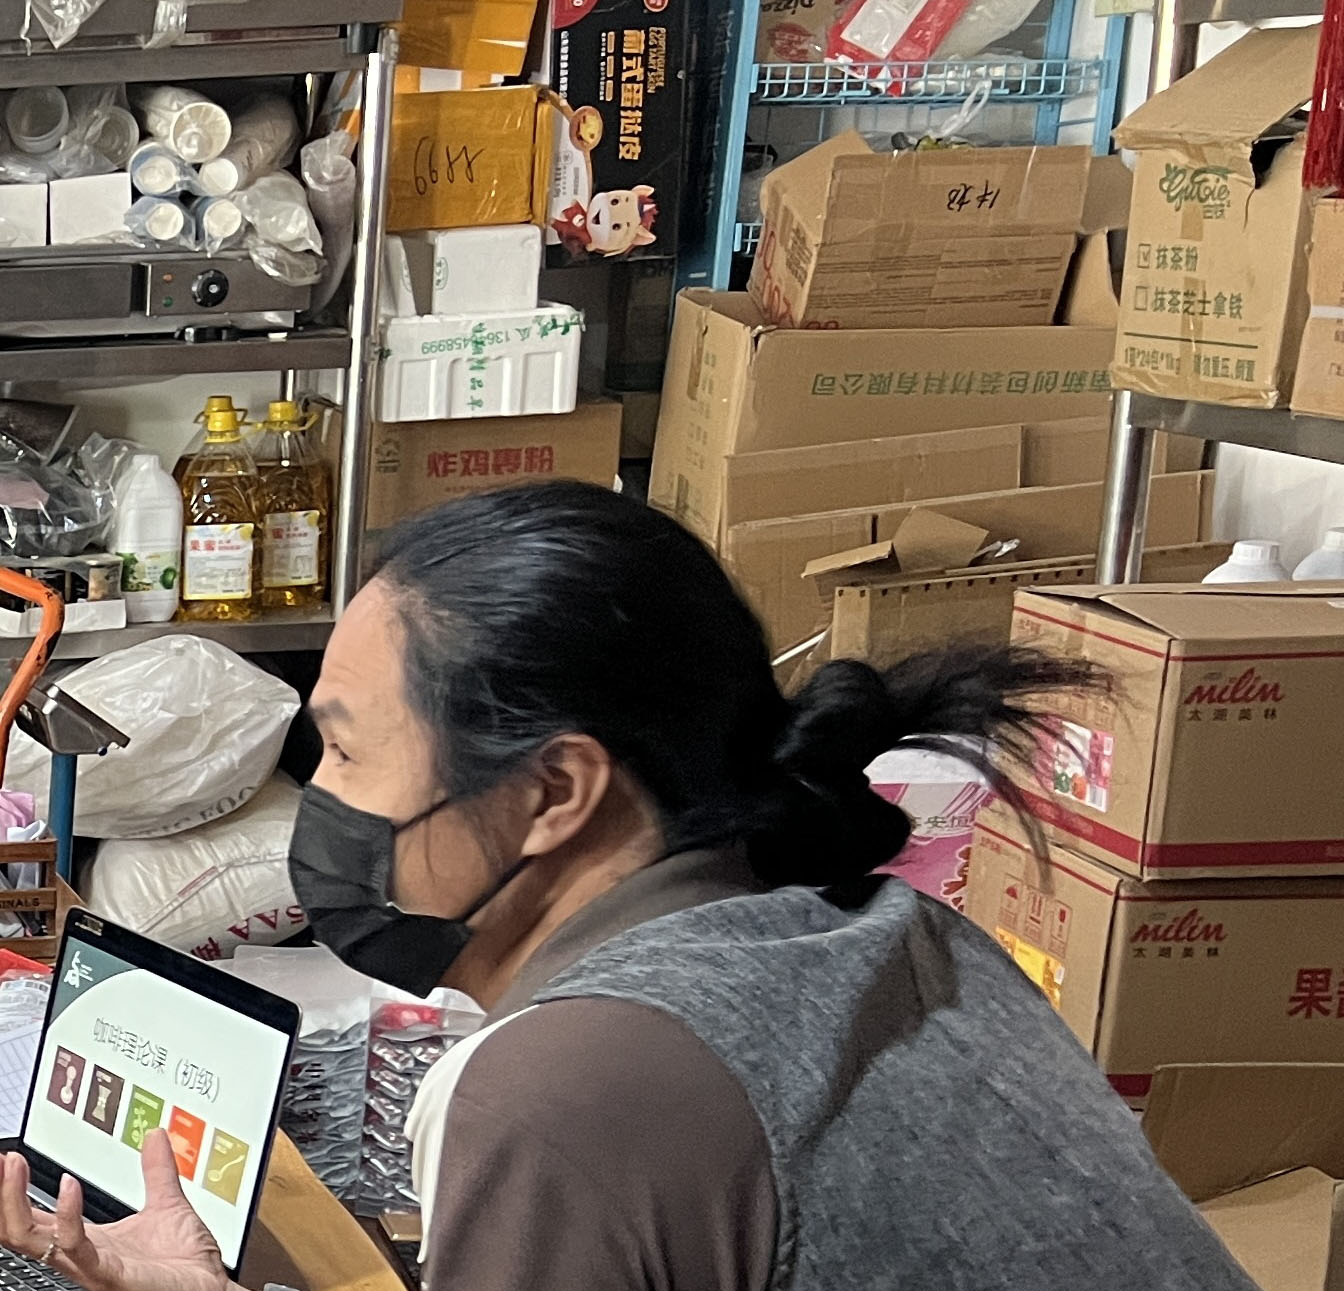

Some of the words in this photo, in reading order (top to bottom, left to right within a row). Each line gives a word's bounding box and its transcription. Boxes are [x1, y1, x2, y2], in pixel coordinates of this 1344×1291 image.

[1155, 245, 1199, 272] 抹茶粉
[1152, 287, 1243, 320] 抹茶芝士拿铁
[1183, 667, 1286, 705] milin
[1130, 908, 1229, 944] milin
